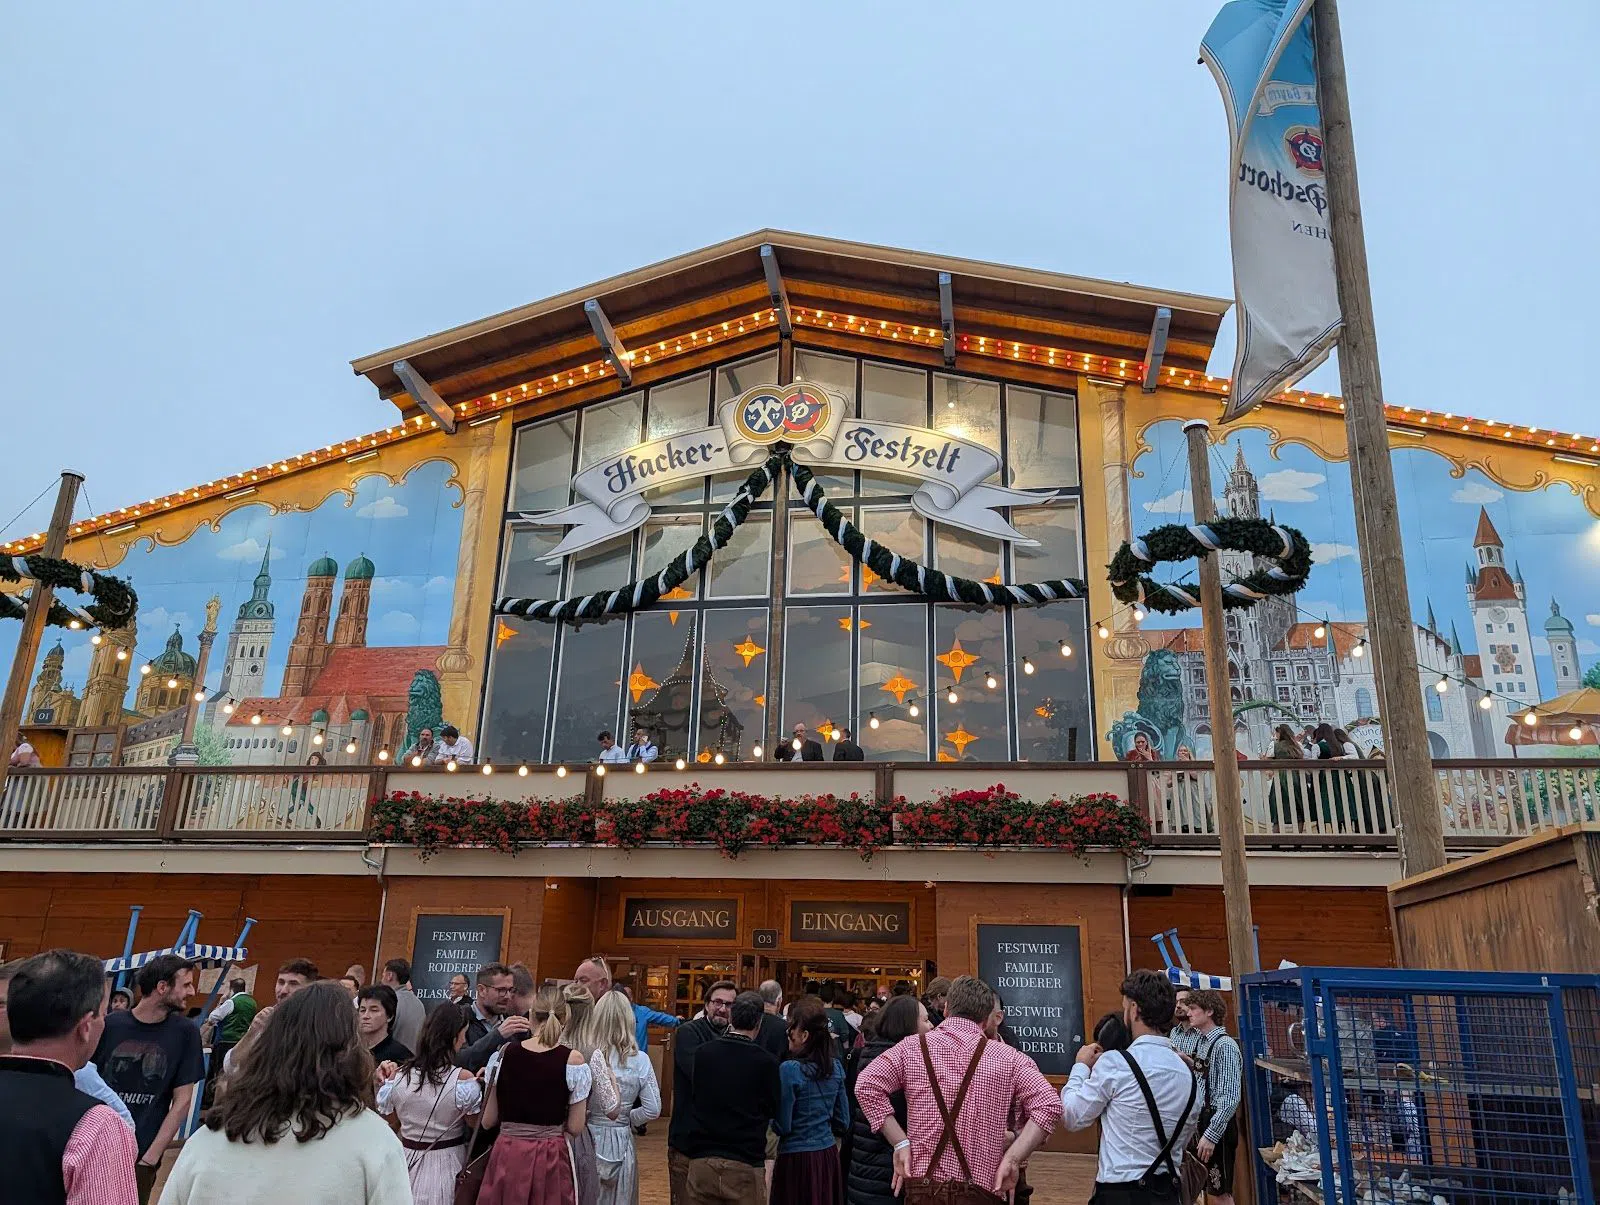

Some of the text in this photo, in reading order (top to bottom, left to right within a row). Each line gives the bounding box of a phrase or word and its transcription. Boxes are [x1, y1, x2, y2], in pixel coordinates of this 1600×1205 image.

[603, 426, 961, 494] Hacker- Festzelt
[631, 909, 730, 928] AUSGANG
[801, 912, 900, 932] EINGANG
[431, 931, 486, 942] FESTWIRT
[997, 942, 1060, 954] FESTWIRT
[435, 949, 478, 960] FAMILIE
[427, 962, 482, 973] ROIDERER
[1004, 962, 1054, 974] FAMILIE
[997, 976, 1062, 989] ROIDERER
[1020, 1041, 1065, 1054] DERER
